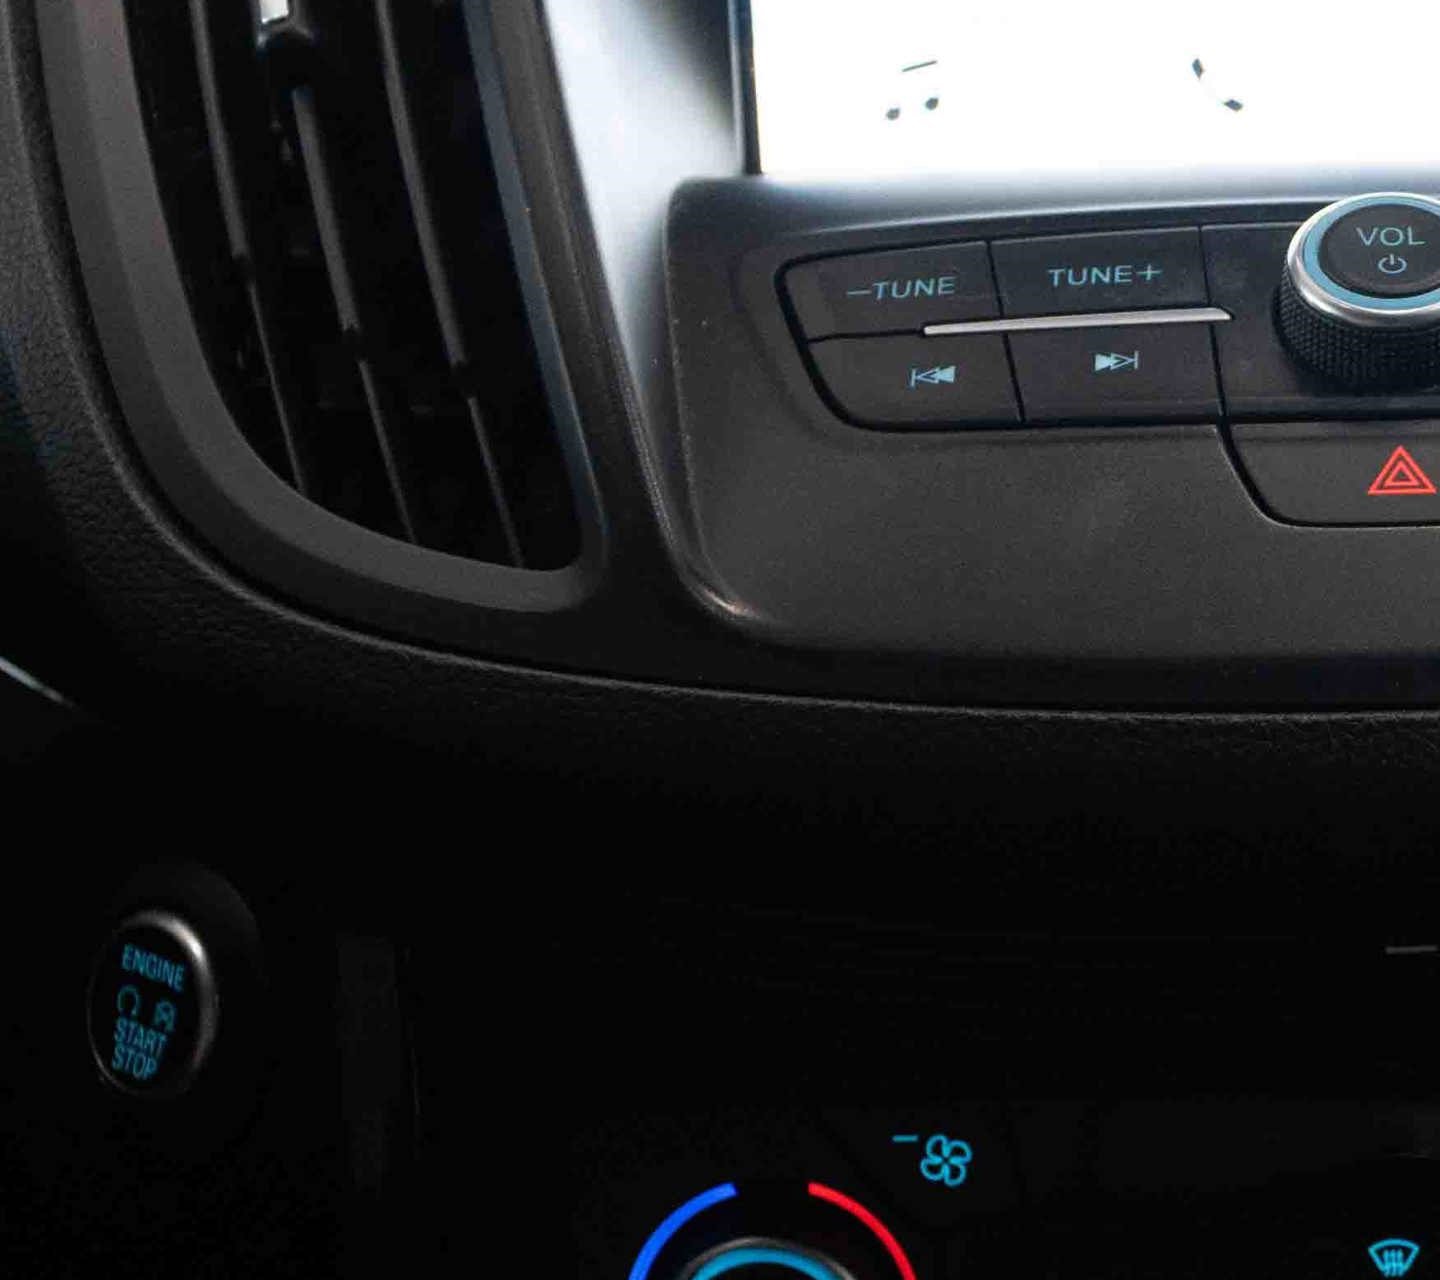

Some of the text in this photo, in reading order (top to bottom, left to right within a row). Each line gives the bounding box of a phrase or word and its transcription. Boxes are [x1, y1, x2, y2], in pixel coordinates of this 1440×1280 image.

[1356, 226, 1425, 247] VOL
[122, 943, 186, 993] ENGINE
[113, 1018, 168, 1056] START
[111, 1043, 159, 1080] STOP
